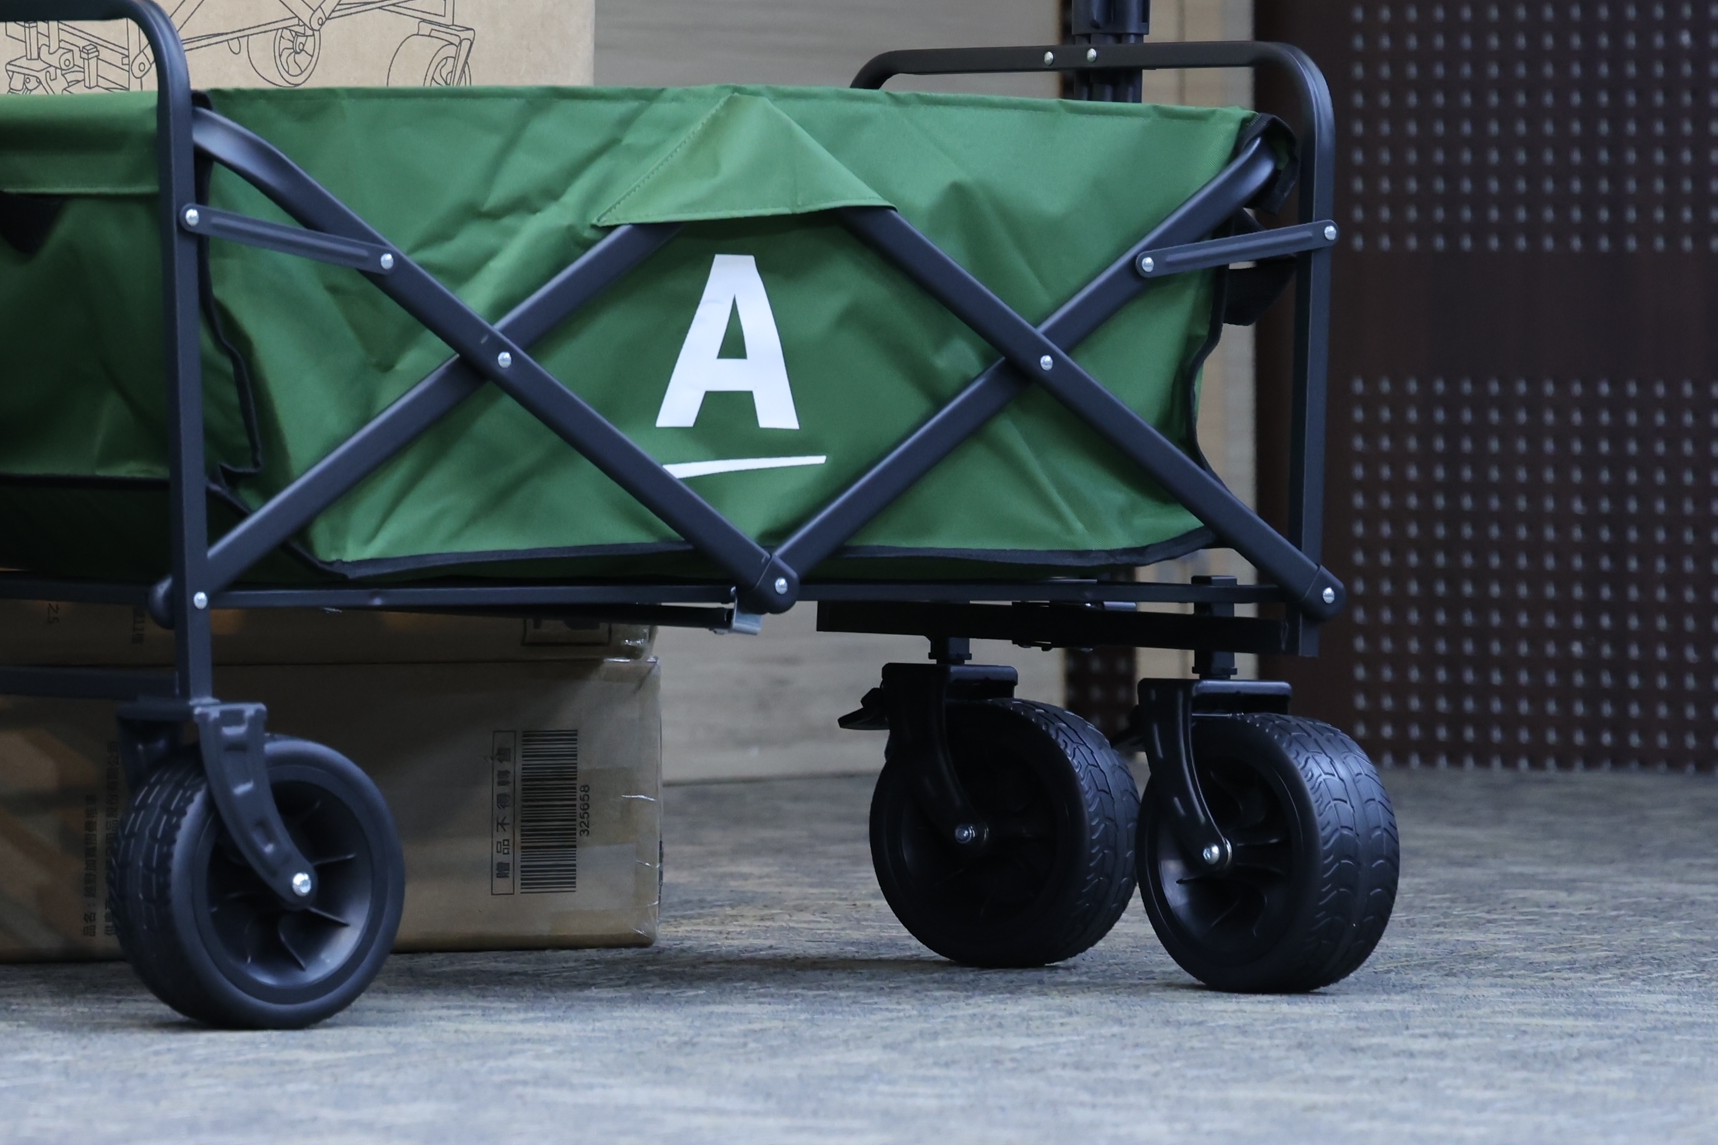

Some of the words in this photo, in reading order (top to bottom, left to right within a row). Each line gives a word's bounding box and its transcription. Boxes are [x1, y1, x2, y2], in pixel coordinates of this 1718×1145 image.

[655, 254, 800, 430] A
[496, 748, 510, 878] 贈品不得轉售
[580, 784, 590, 837] 325658
